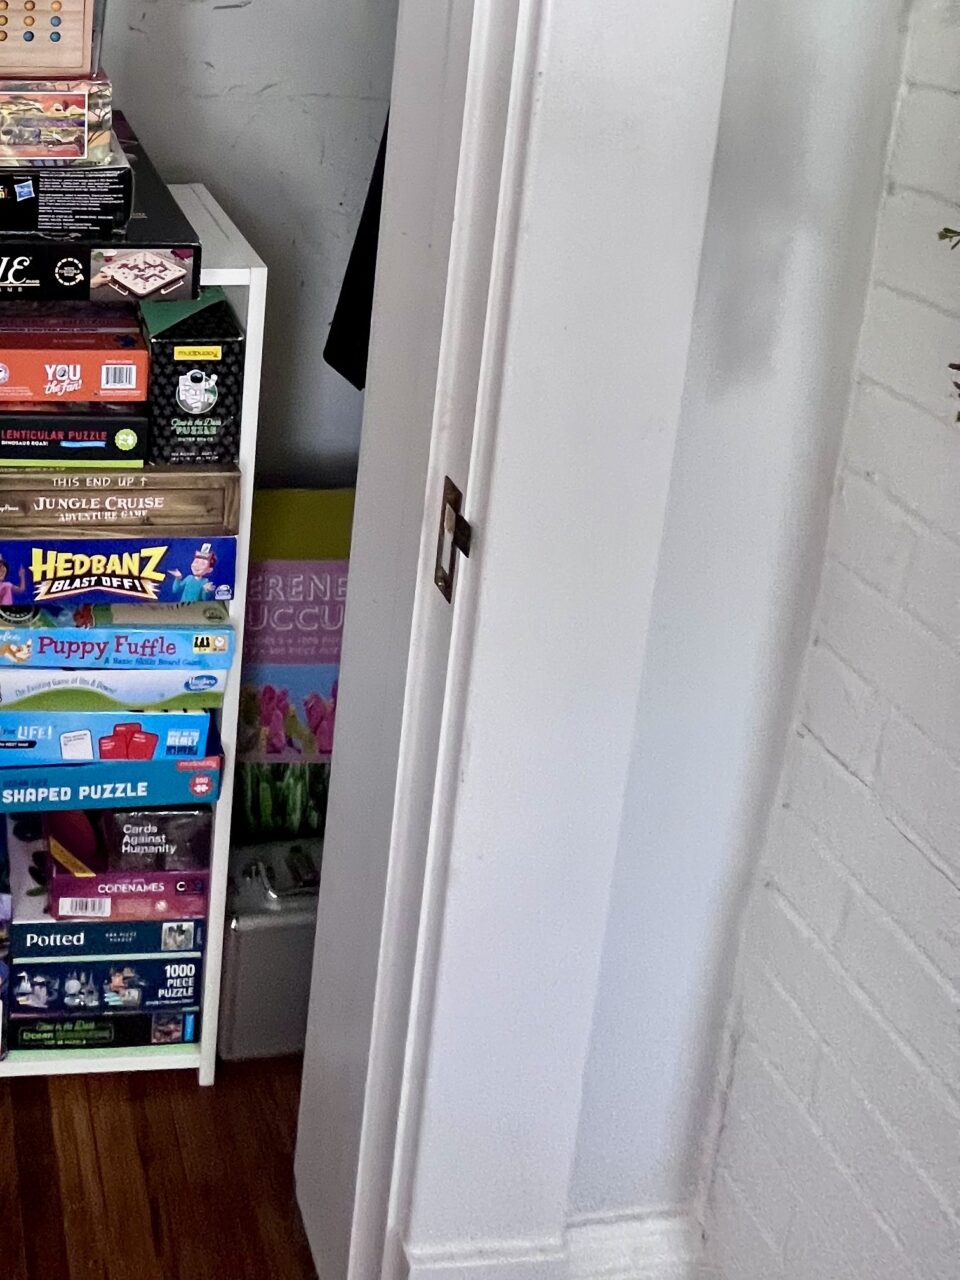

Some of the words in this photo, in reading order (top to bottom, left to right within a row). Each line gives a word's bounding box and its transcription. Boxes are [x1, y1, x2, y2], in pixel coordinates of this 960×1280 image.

[44, 364, 81, 381] YOU
[44, 380, 60, 395] the
[58, 379, 83, 396] fan!
[0, 429, 65, 441] LENTICULAR
[68, 430, 108, 441] PUZZLE
[176, 426, 217, 435] PUZZLE
[52, 477, 80, 487] THIS
[86, 477, 111, 487] END
[118, 477, 134, 486] UP
[33, 496, 100, 511] JUNGLE
[104, 496, 165, 511] CRUISE
[58, 510, 118, 522] ADVENTURE
[120, 509, 149, 519] GAME
[29, 545, 169, 583] HEDBANZ
[50, 577, 98, 593] BLAST
[101, 576, 142, 592] OFF!
[247, 574, 348, 601] ERENE
[37, 635, 109, 660] Puppy
[114, 635, 177, 658] Fuffle
[17, 725, 53, 740] LIFE!
[2, 786, 72, 803] SHAPED
[78, 782, 148, 799] PUZZLE
[123, 823, 158, 835] Cards
[122, 833, 166, 845] Against
[121, 843, 176, 855] Humanity
[97, 882, 165, 893] CODENAMES
[25, 931, 85, 947] Potted
[164, 963, 196, 978] 1000
[167, 977, 195, 988] PIECE
[158, 987, 194, 998] PUZZLE
